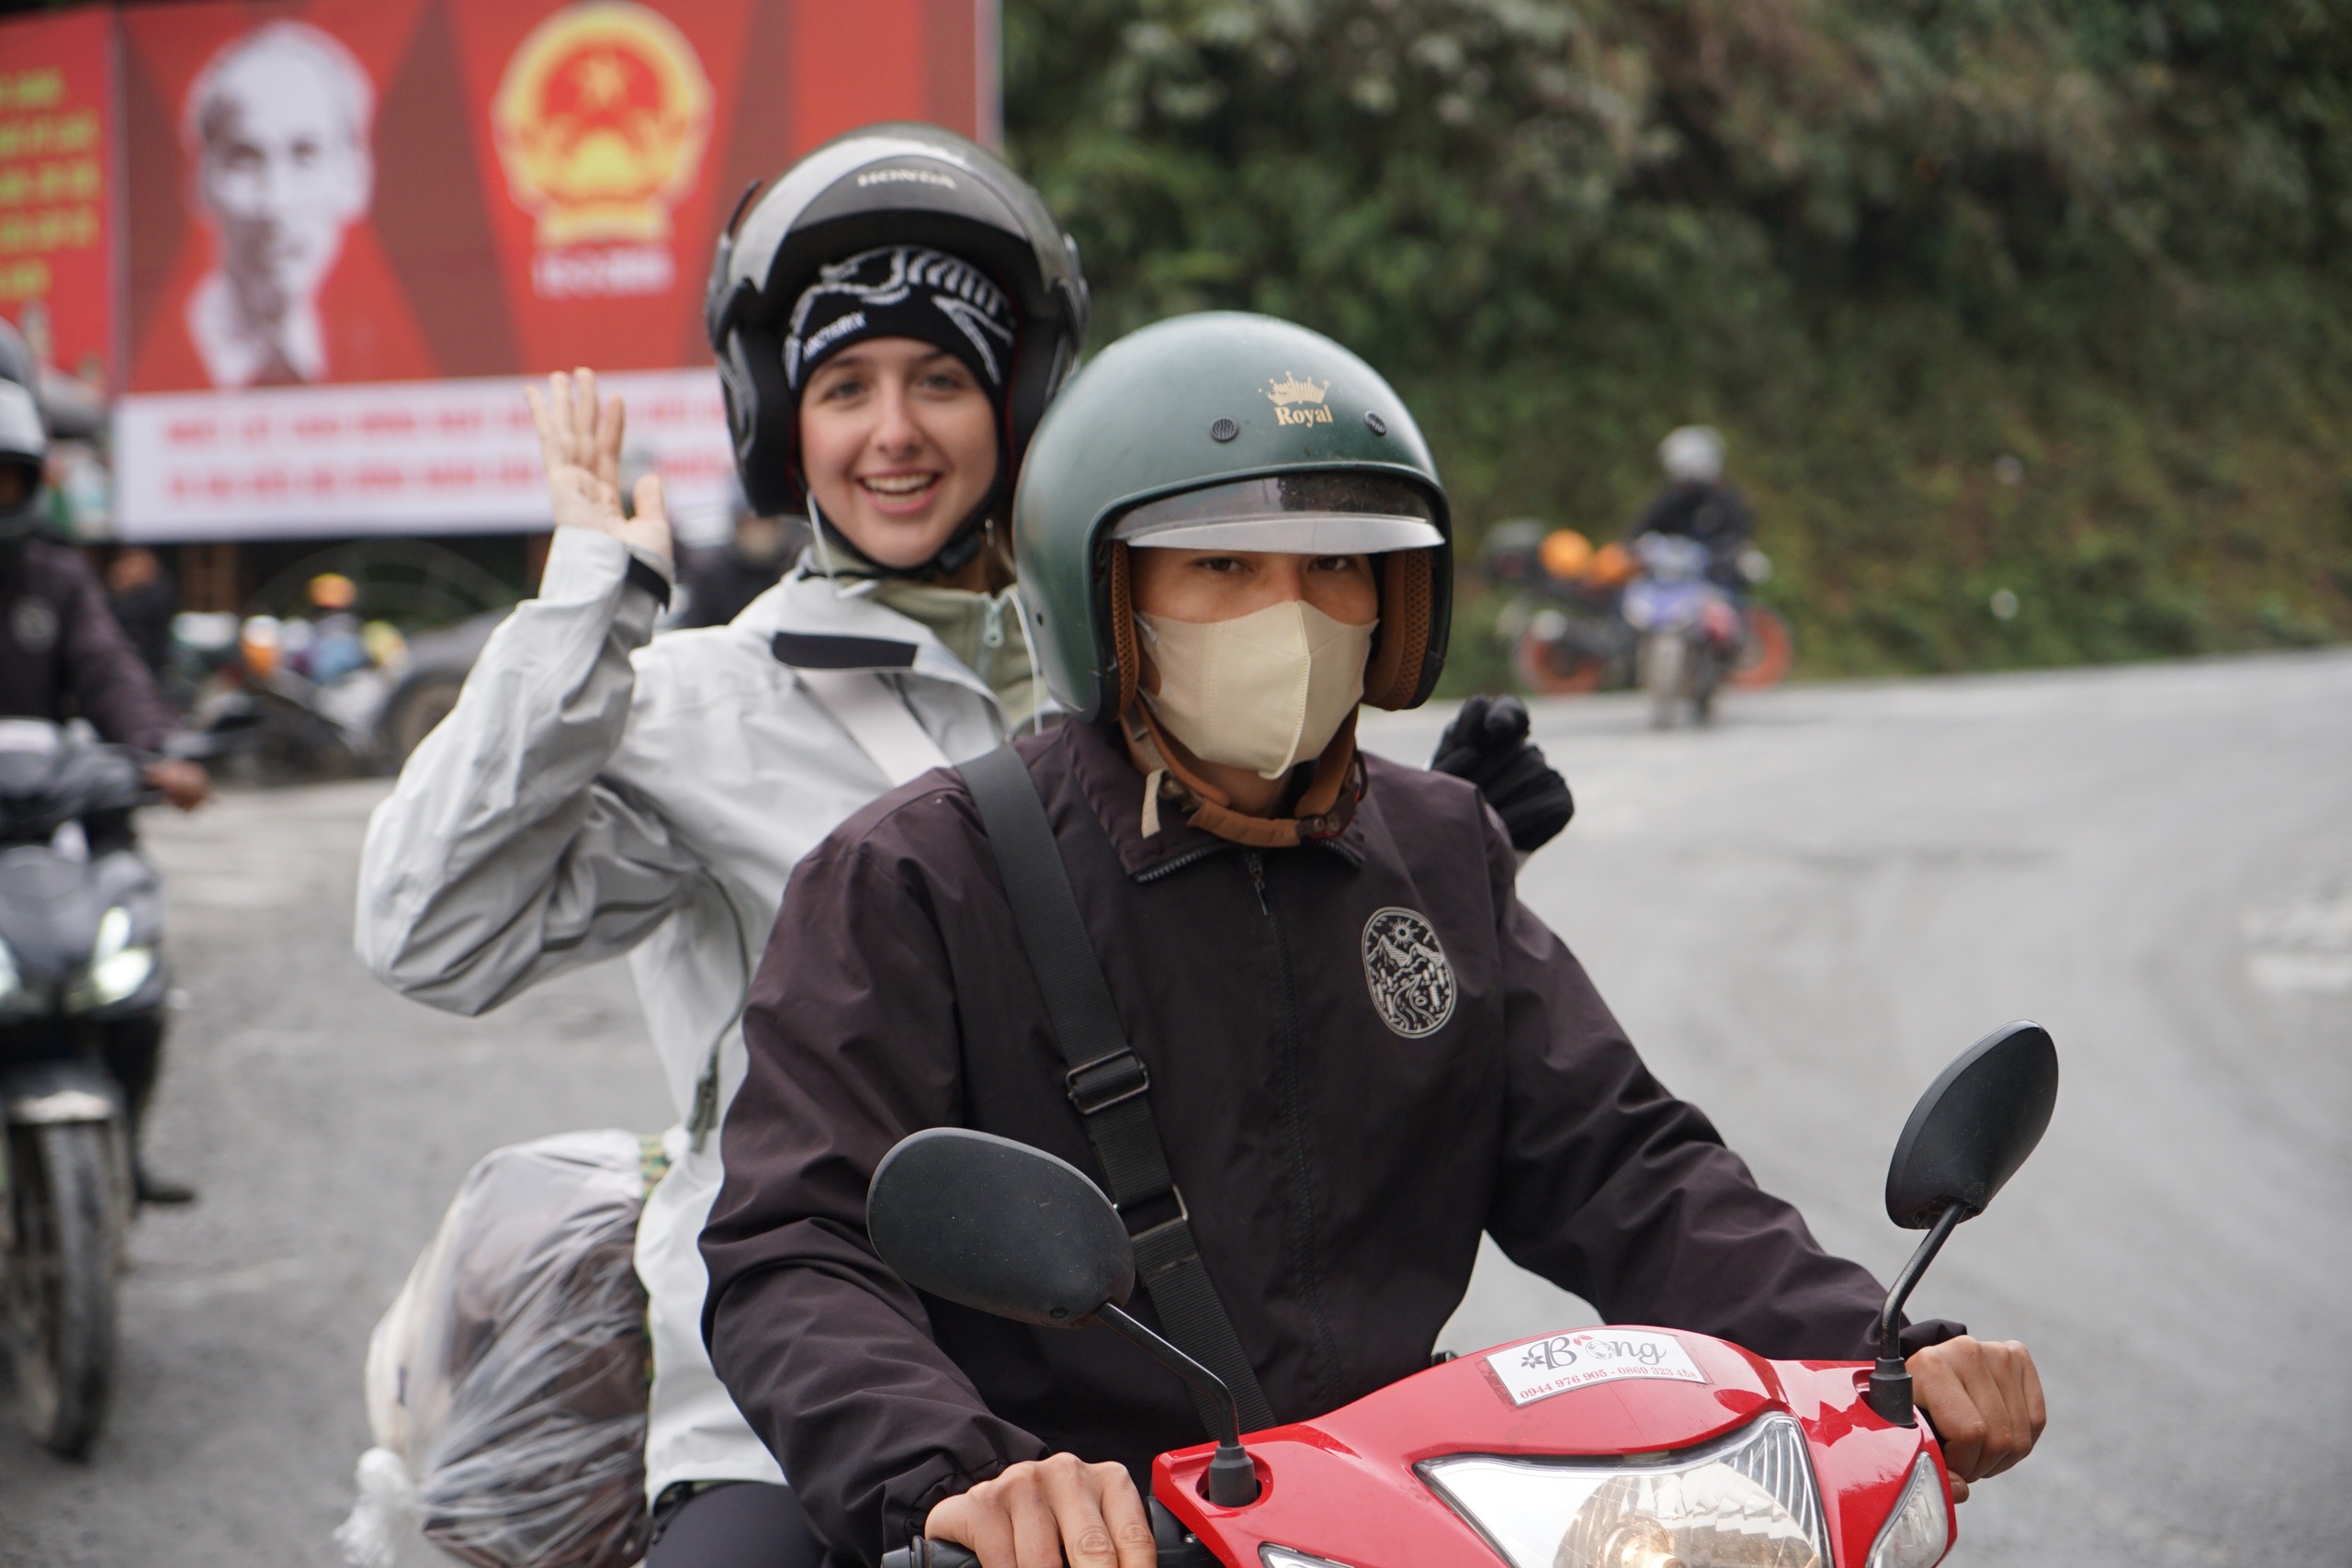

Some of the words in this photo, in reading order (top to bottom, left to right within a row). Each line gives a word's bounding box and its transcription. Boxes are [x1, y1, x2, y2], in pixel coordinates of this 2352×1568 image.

[1273, 404, 1333, 428] Royal
[1520, 1380, 1553, 1400] 0944
[1555, 1374, 1580, 1388] 976
[1582, 1369, 1608, 1382] 905
[1618, 1366, 1649, 1376] 0869
[1651, 1367, 1674, 1376] 323
